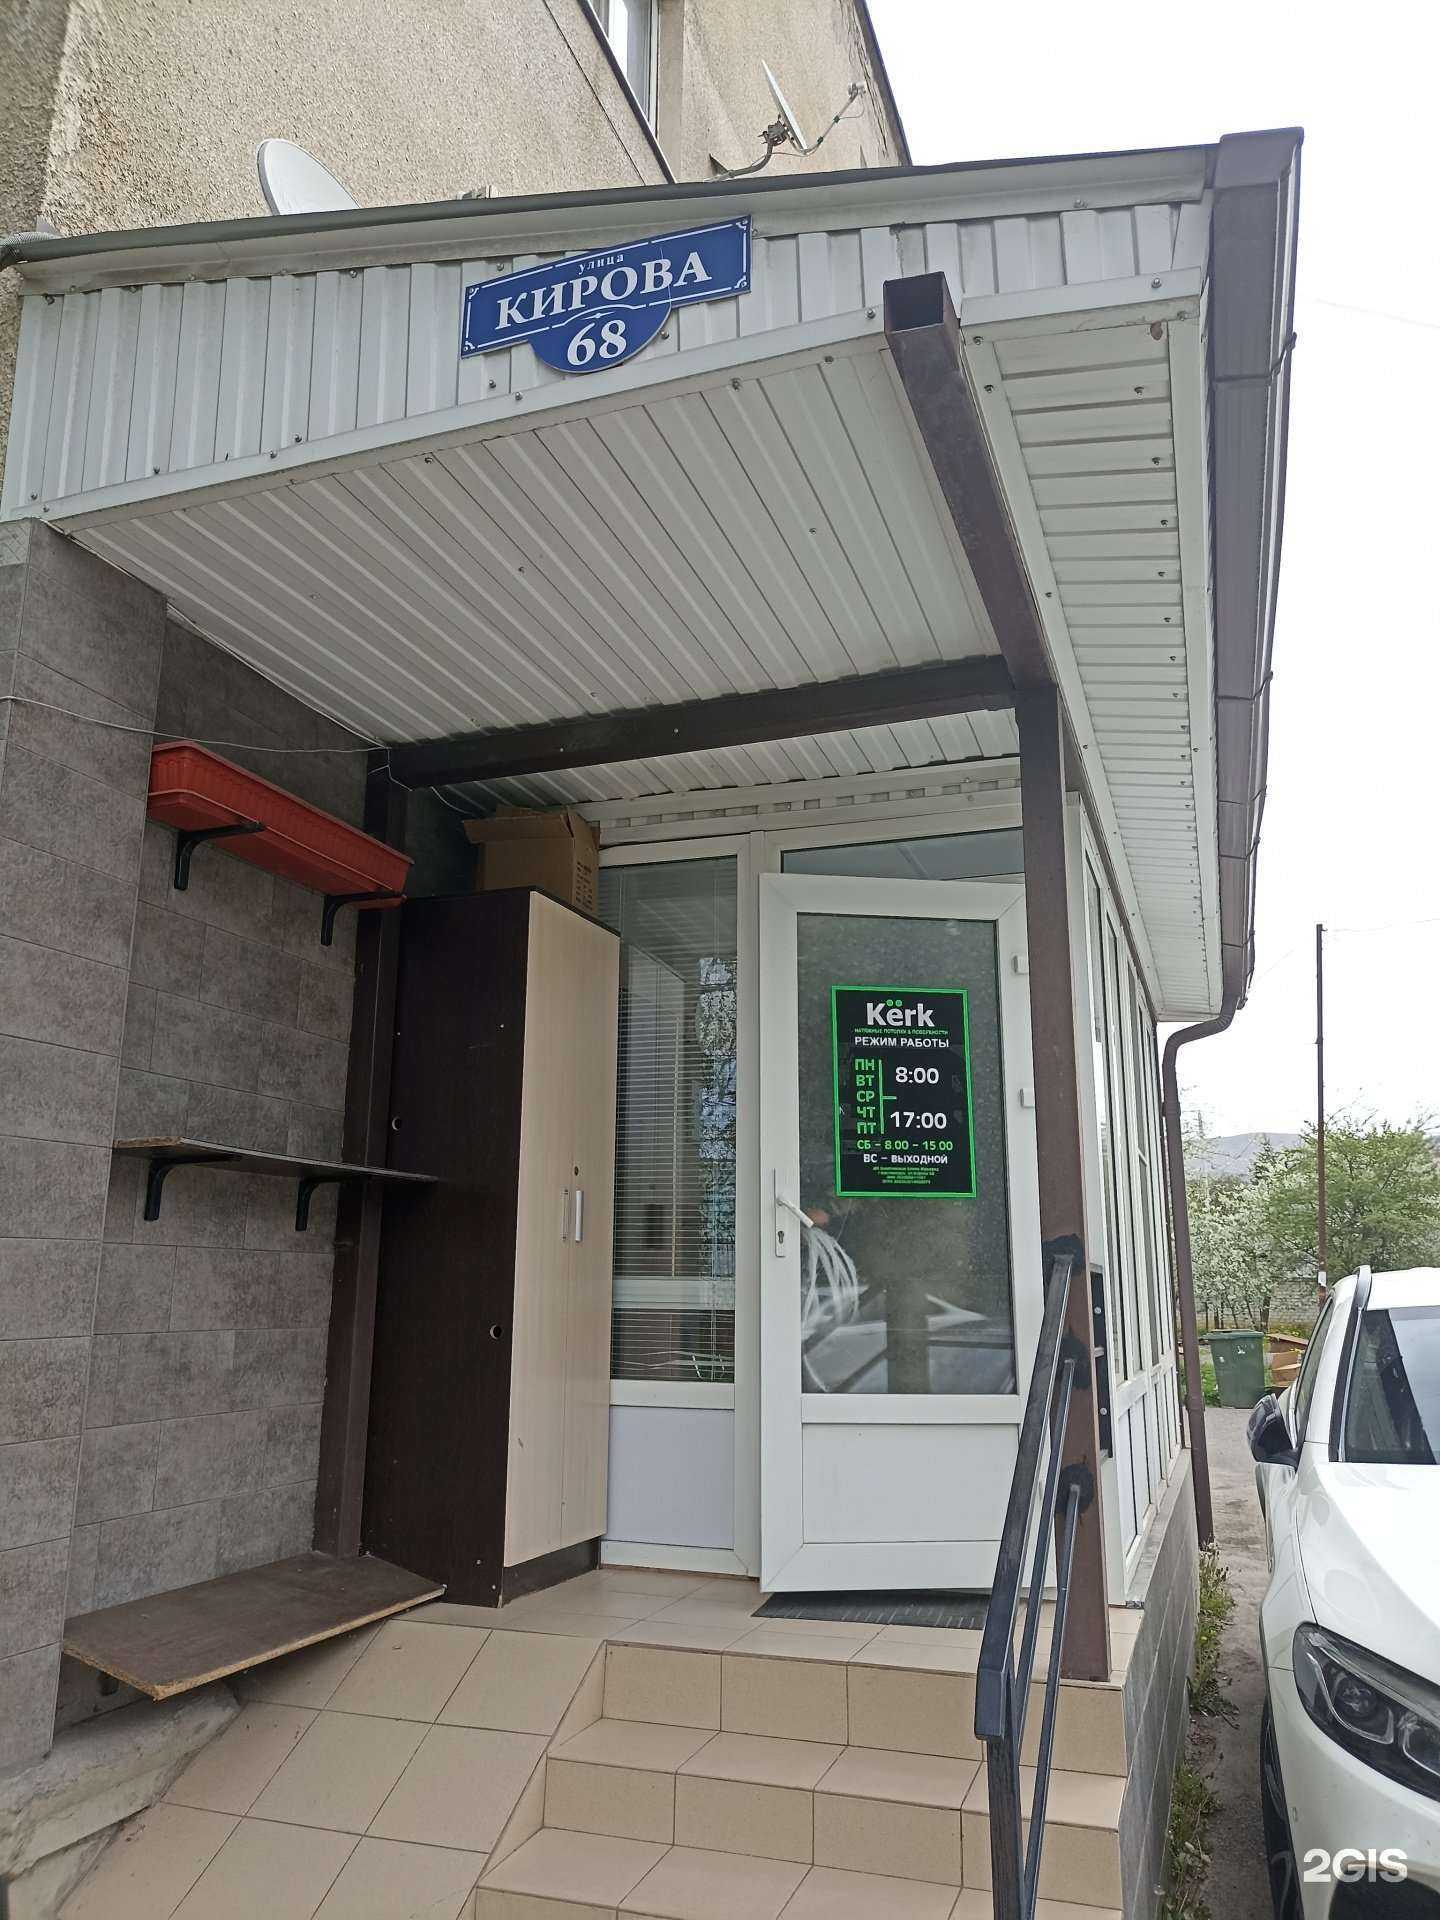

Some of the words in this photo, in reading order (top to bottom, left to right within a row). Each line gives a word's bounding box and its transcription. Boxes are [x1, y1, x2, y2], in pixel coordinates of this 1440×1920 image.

[577, 252, 625, 275] улица
[495, 251, 713, 330] КИРОВА
[566, 319, 627, 366] 68
[866, 999, 935, 1027] Kërk
[854, 1036, 897, 1047] РЕЖИМ
[900, 1037, 949, 1048] РАБОТЫ
[855, 1059, 875, 1071] ПН
[856, 1075, 875, 1087] ВТ
[895, 1066, 940, 1085] 8:00
[856, 1090, 875, 1103] СР
[857, 1106, 876, 1118] ЧТ
[890, 1111, 947, 1130] 17:00
[857, 1122, 877, 1134] ПТ
[857, 1139, 871, 1150] СБ
[884, 1140, 909, 1150] 8.00
[863, 1153, 878, 1163] ВС
[891, 1154, 948, 1164] ВЫХОДНОЙ
